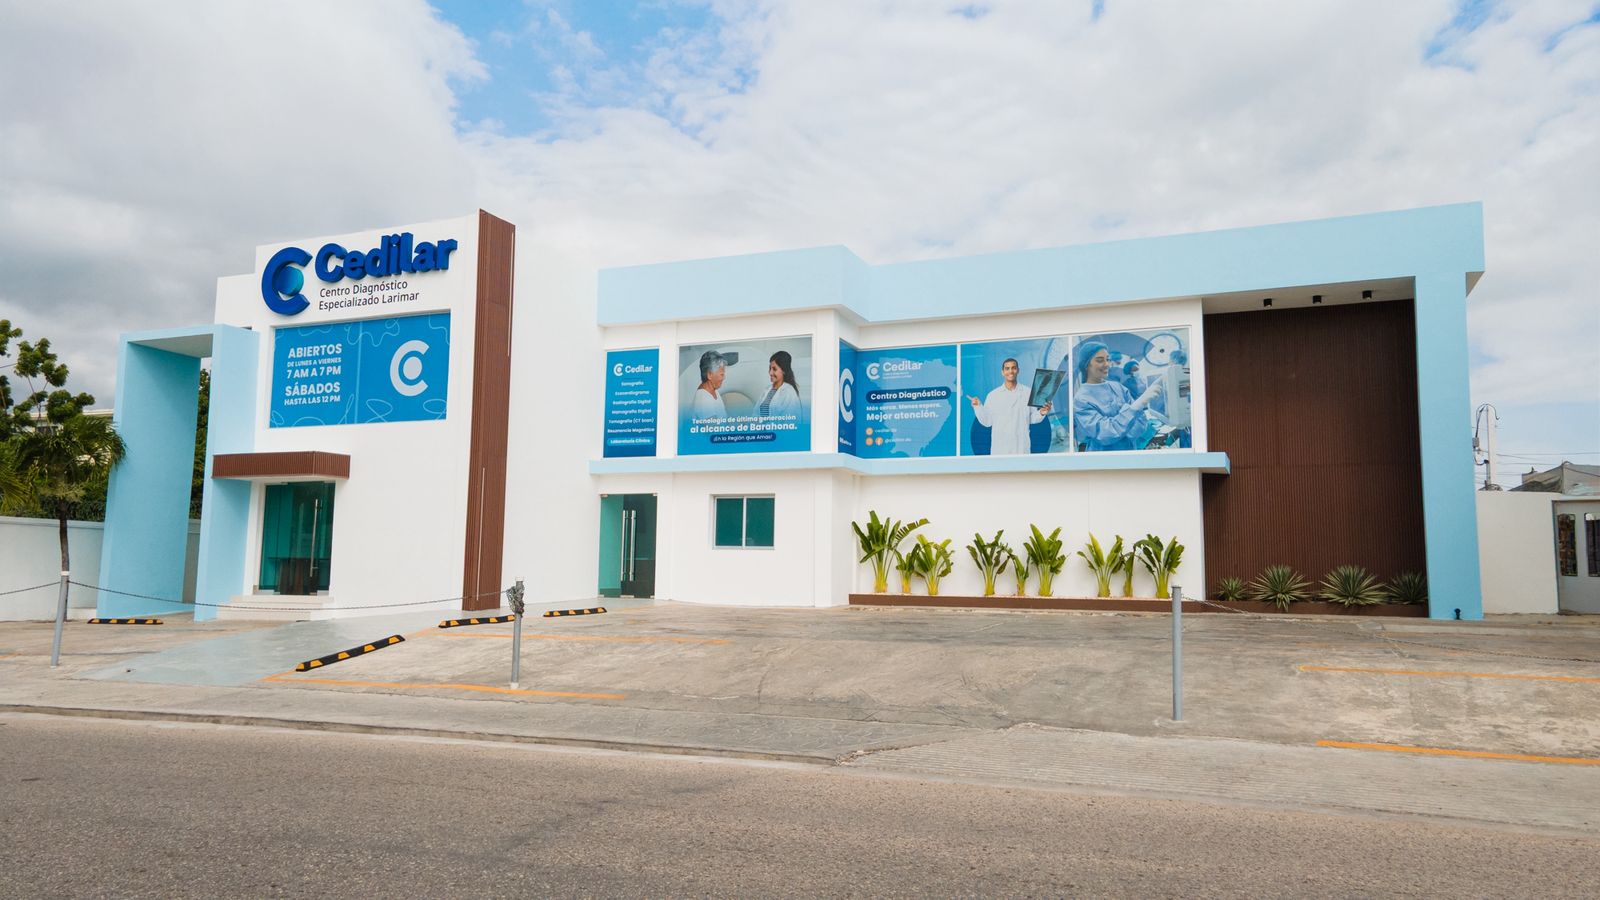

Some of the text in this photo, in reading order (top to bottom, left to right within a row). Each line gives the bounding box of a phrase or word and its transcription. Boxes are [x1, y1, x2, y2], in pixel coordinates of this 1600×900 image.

[315, 232, 458, 283] Cedilar
[320, 280, 408, 298] Centro Diagnóstico
[318, 291, 420, 312] Especializado Larimar
[288, 343, 342, 358] ABIERTOS
[625, 364, 653, 373] Cedilar
[883, 360, 923, 372] Cedilar
[287, 366, 341, 379] 7 AM A 7 PM
[285, 382, 340, 396] SÁBADOS
[899, 390, 946, 399] Diagnóstico
[284, 398, 307, 406] HASTA
[759, 414, 796, 423] generación
[866, 410, 939, 422] Mejor atención.
[750, 422, 797, 431] Barahona.
